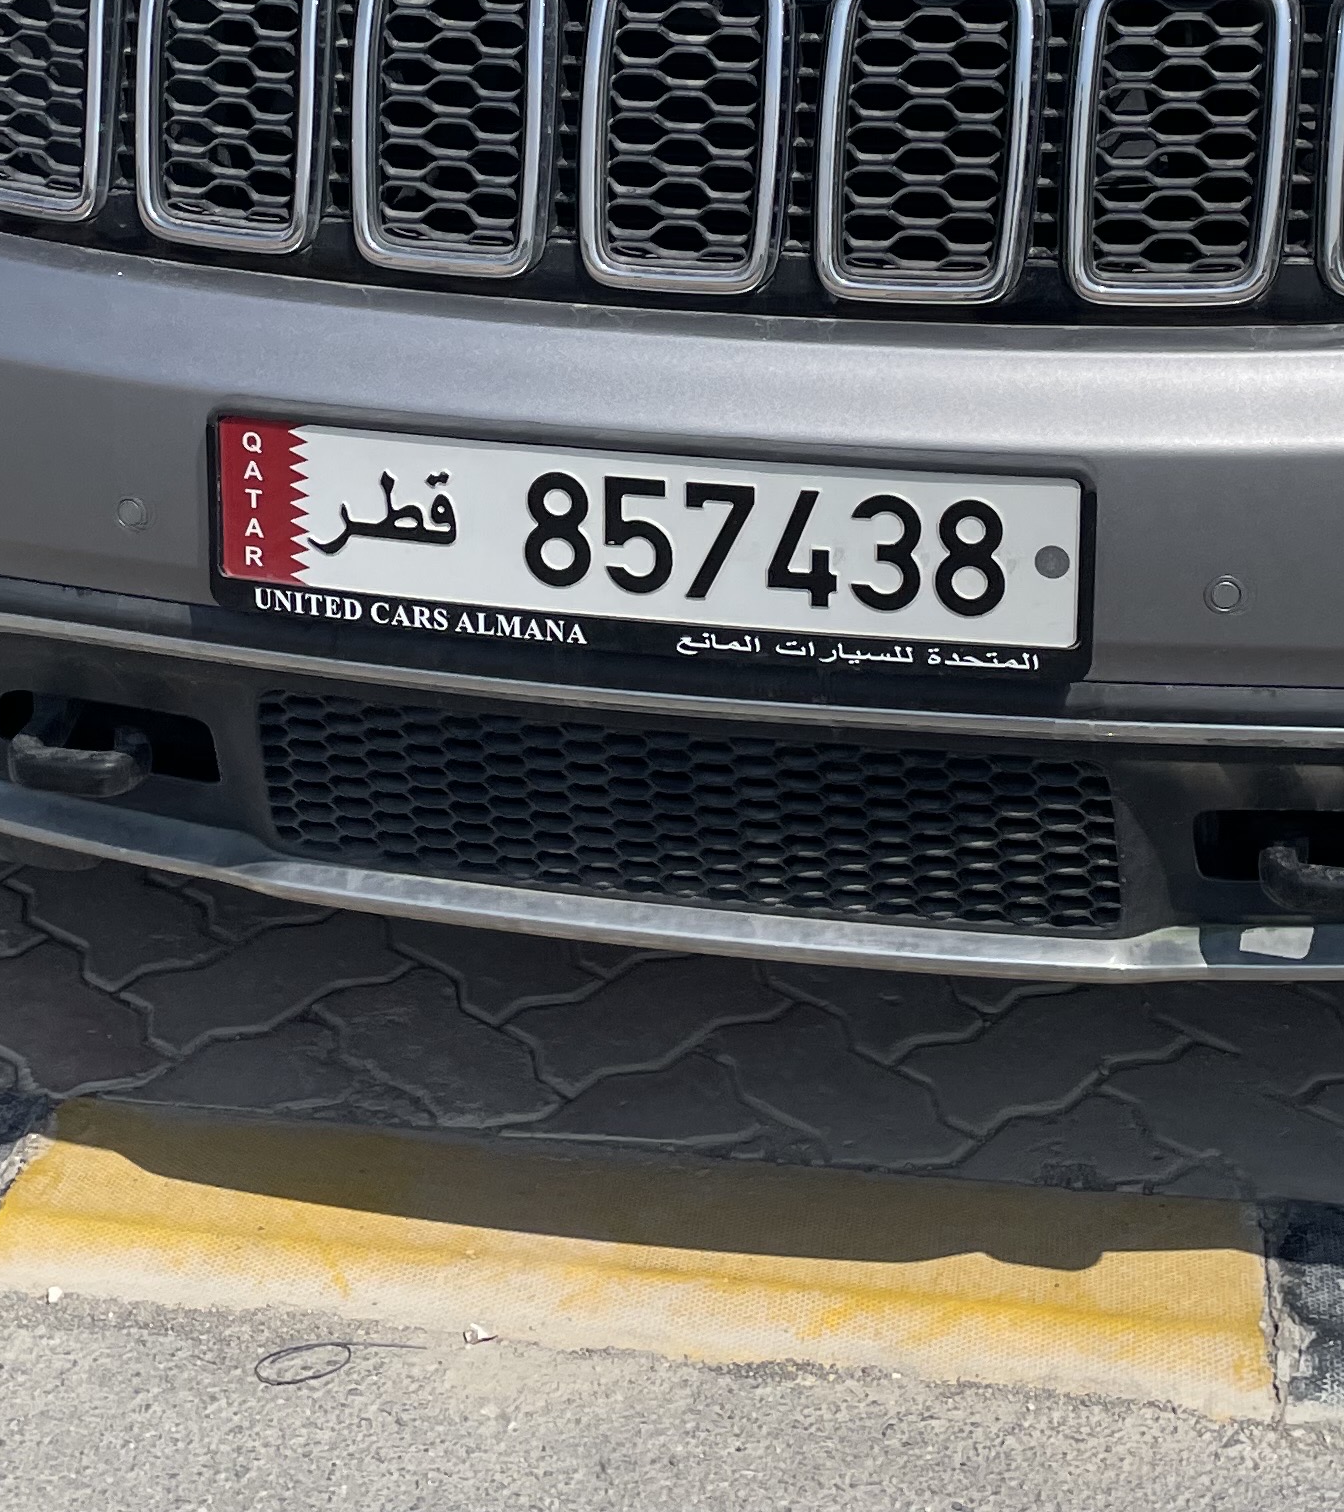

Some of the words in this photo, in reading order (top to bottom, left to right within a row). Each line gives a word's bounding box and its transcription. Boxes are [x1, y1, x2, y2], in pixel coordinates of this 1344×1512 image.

[242, 430, 265, 567] QATAR
[307, 469, 458, 556] قطر
[524, 470, 1006, 618] 857438
[253, 586, 362, 622] UNITED
[370, 601, 449, 632] CARS
[454, 610, 588, 646] ALMANA
[675, 631, 761, 655] المانع
[774, 638, 914, 666] للسيارات
[926, 650, 1040, 672] المتحدة
